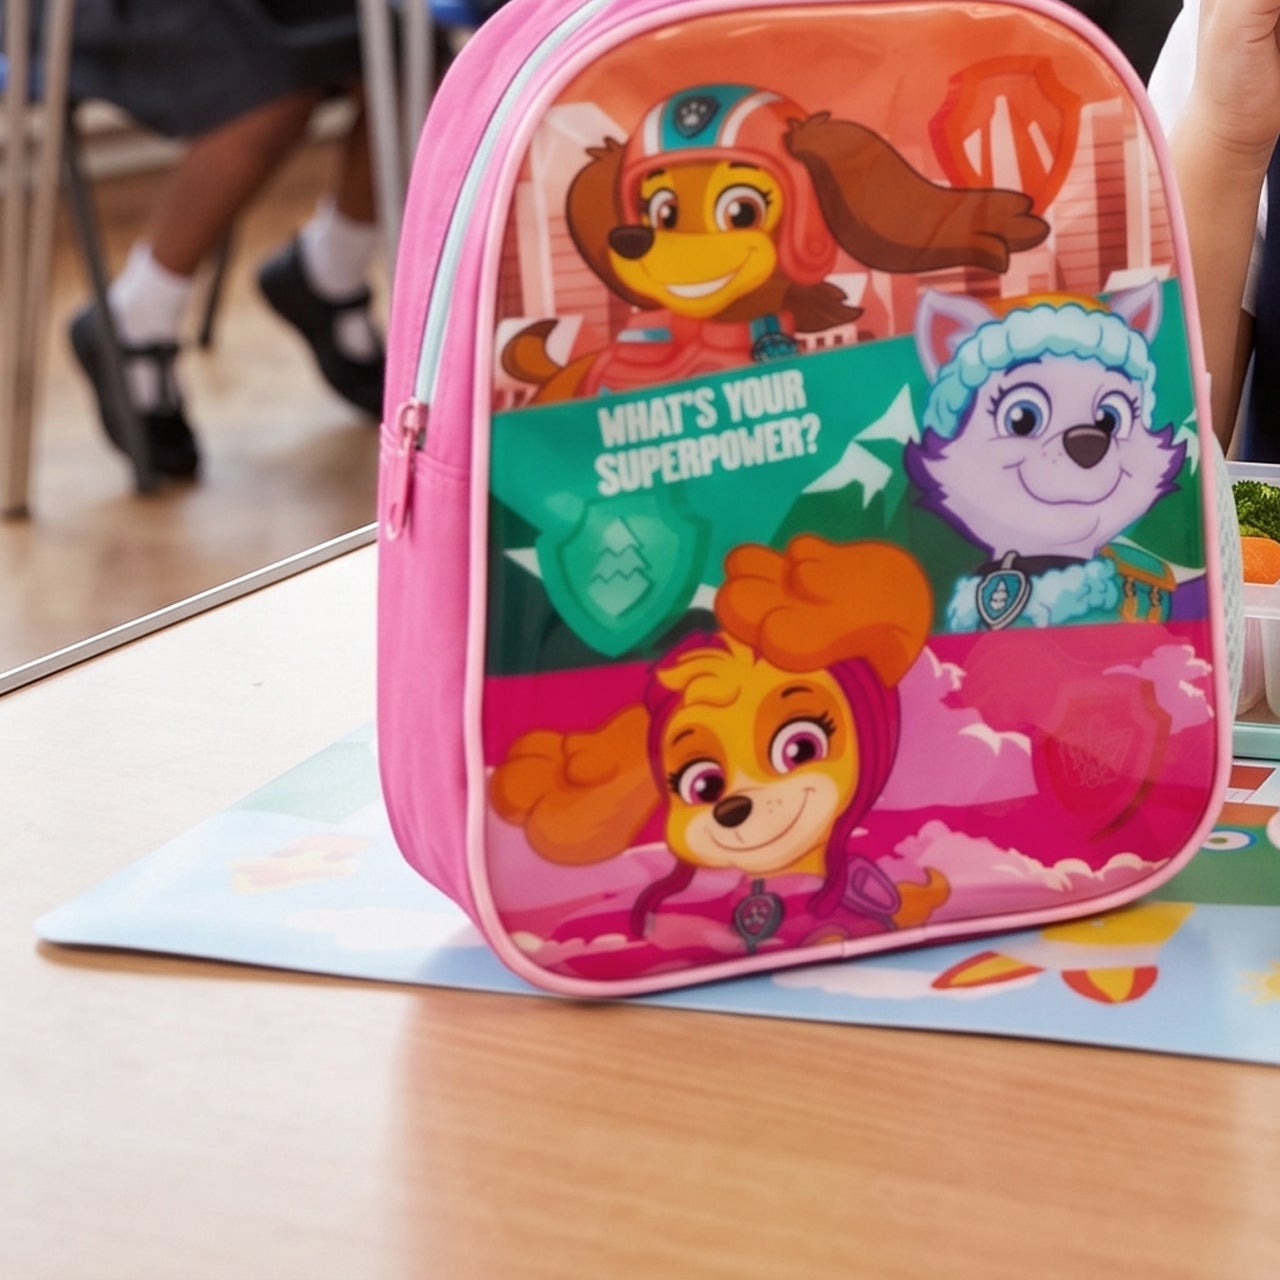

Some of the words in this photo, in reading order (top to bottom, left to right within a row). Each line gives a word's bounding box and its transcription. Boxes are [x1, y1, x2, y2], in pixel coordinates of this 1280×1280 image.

[597, 387, 718, 448] WHAT'S
[722, 369, 807, 423] YOUR
[594, 412, 821, 497] SUPERPOWER?
